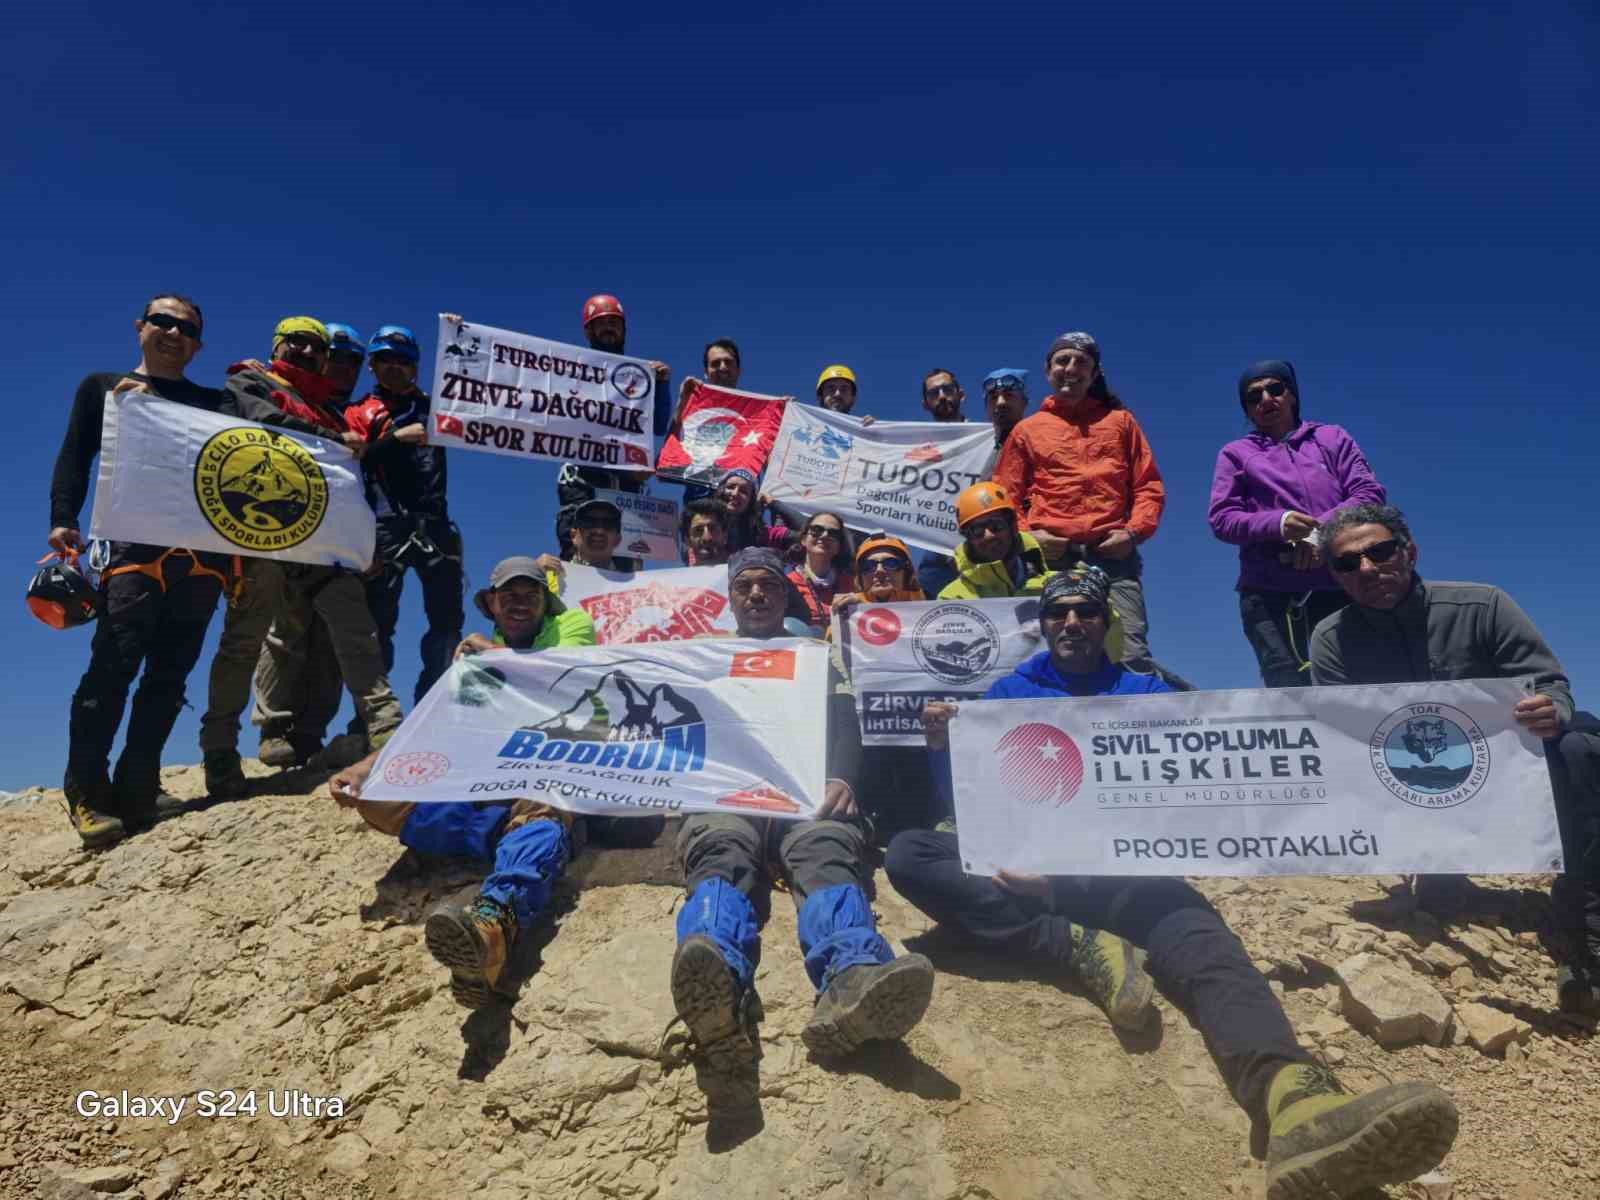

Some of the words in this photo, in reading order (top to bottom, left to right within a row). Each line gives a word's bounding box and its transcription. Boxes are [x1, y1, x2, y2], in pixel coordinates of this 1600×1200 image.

[493, 343, 607, 384] TURGUTLU
[441, 368, 522, 410] ZİRVE
[530, 389, 644, 434] DAĞCILIK
[464, 421, 525, 451] SPOR
[530, 431, 621, 465] KULÜBÜ
[858, 457, 980, 494] TUDOST
[201, 476, 221, 517] DOĞA
[219, 518, 288, 545] SPORLARI
[856, 500, 911, 522] Sporları
[916, 513, 957, 532] Kulüb
[916, 499, 933, 510] ve
[938, 500, 959, 517] Do
[867, 715, 926, 730] İHTİSA
[1408, 705, 1443, 715] TOAK
[497, 722, 705, 772] BODRUM
[1091, 733, 1160, 755] SİVİL
[1164, 728, 1320, 752] TOPLUMLA
[1095, 755, 1323, 784] İLİŞKİLER
[1376, 762, 1422, 803] OCAKLARI
[1427, 787, 1471, 805] ARAMA
[534, 778, 592, 798] SPOR
[1097, 791, 1168, 803] GENEL
[1113, 838, 1208, 859] PROJE
[1217, 829, 1379, 858] ORTAKLIĞI
